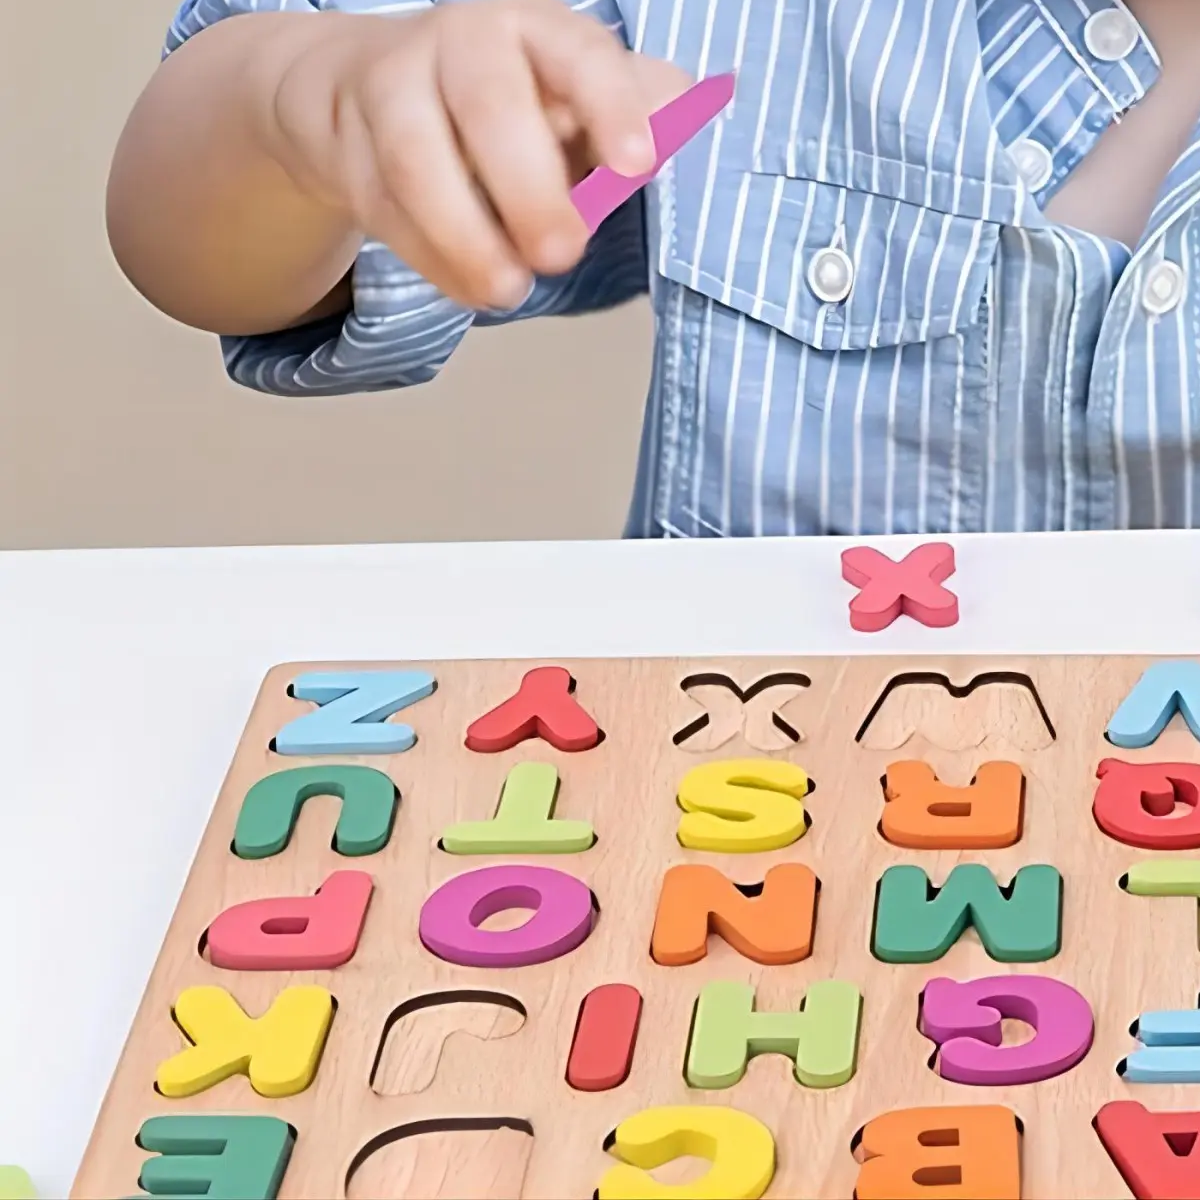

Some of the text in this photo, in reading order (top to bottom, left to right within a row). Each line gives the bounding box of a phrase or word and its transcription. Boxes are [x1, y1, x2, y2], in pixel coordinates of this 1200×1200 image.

[841, 542, 960, 633] X
[275, 670, 437, 755] Z
[465, 666, 601, 753] Y
[233, 764, 397, 859] U
[441, 761, 594, 854] T
[676, 758, 811, 853] S
[880, 760, 1025, 849] R
[209, 869, 374, 971] P
[419, 865, 594, 968] O
[651, 862, 819, 965] N
[157, 985, 333, 1097] K
[686, 979, 861, 1089] H
[921, 974, 1095, 1086] G
[117, 1115, 292, 1200] E
[598, 1105, 776, 1200] C
[856, 1104, 1022, 1200] B
